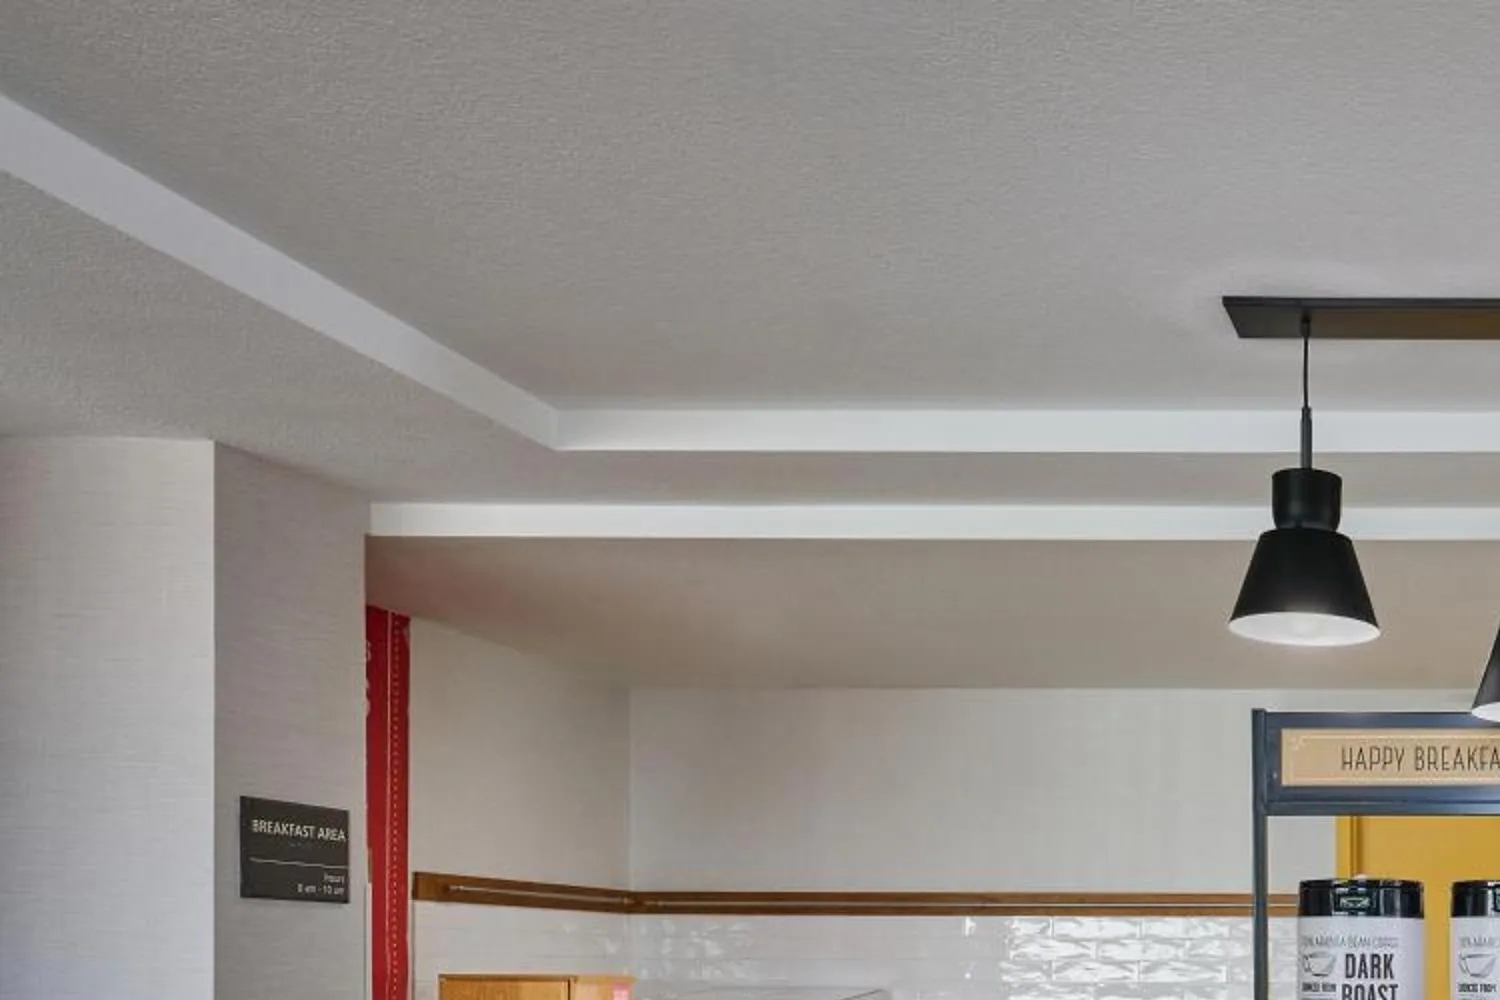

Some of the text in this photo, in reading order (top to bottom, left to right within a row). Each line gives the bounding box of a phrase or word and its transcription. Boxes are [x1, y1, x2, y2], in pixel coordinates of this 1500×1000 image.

[1341, 746, 1405, 772] HAPPY
[252, 819, 346, 842] BREAKFAST AREA
[1345, 953, 1394, 979] DARK
